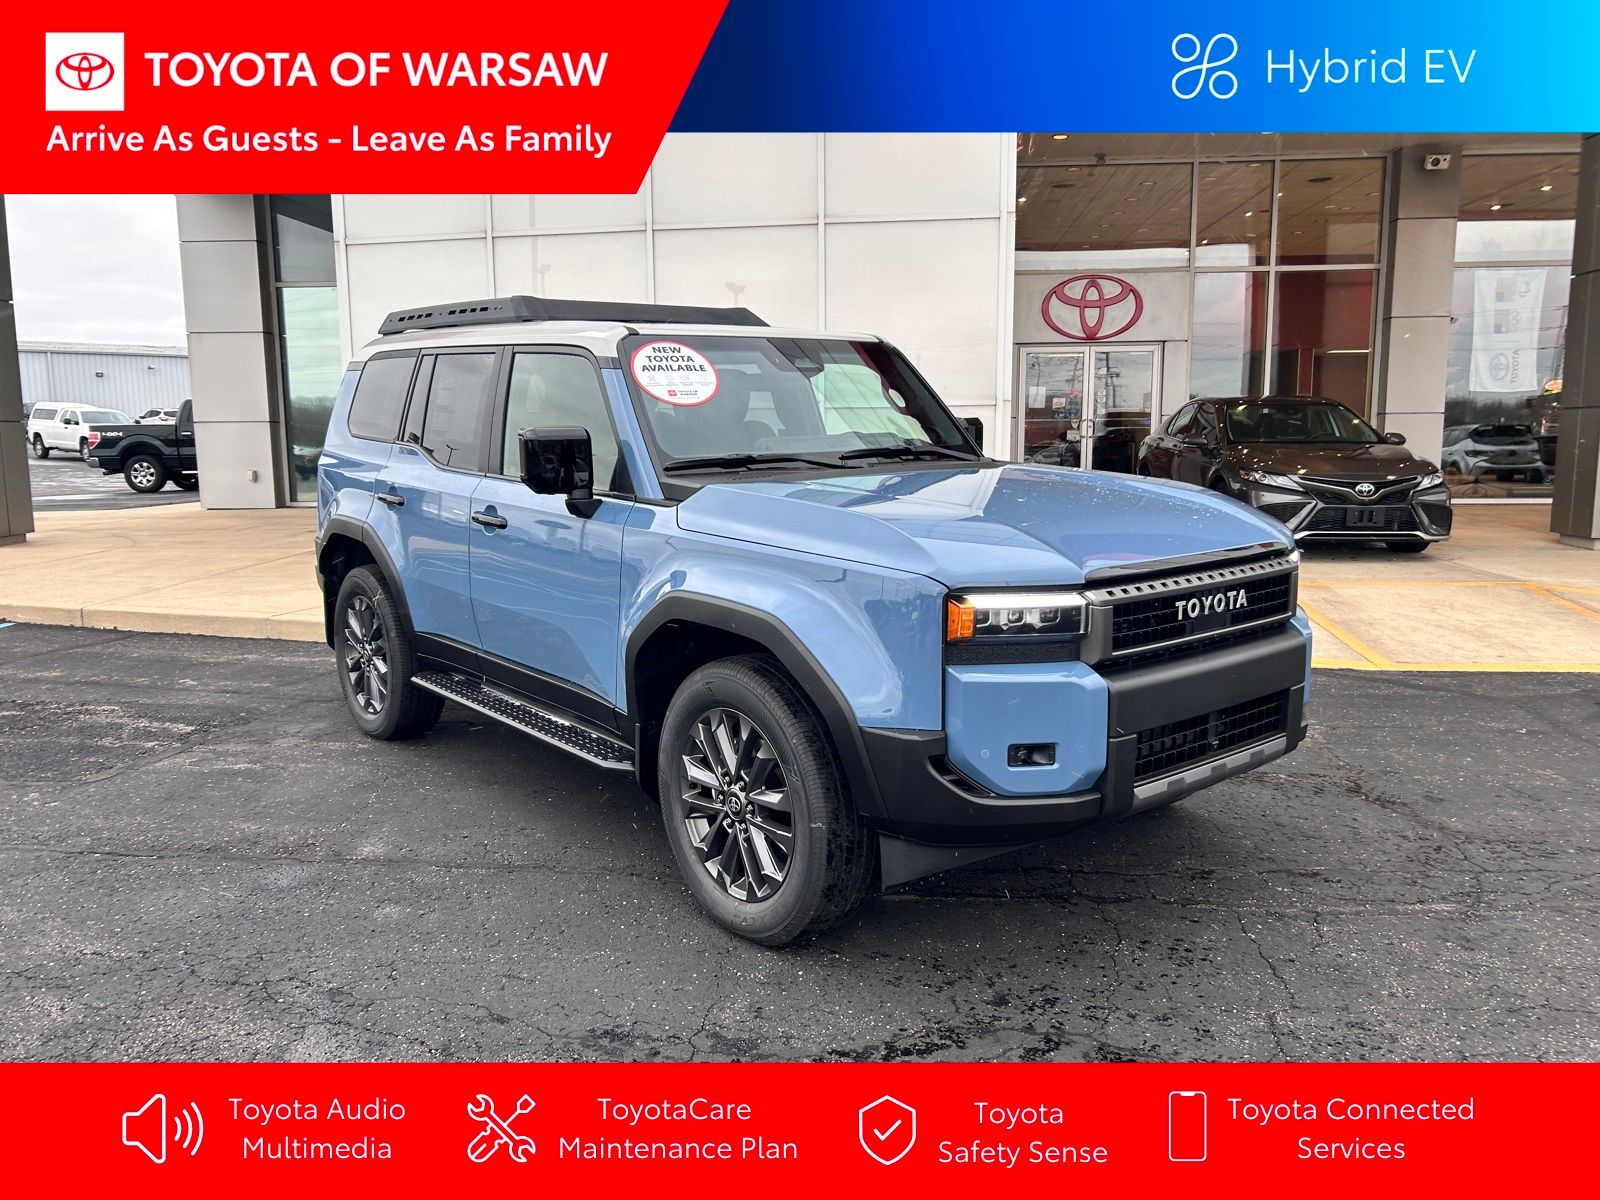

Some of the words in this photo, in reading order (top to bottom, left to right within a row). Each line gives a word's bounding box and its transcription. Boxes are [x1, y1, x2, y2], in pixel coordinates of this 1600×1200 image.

[652, 346, 681, 354] NEW
[645, 355, 695, 363] TOYOTA
[641, 364, 707, 373] AVAILABLE
[1175, 589, 1248, 621] TOYOTA
